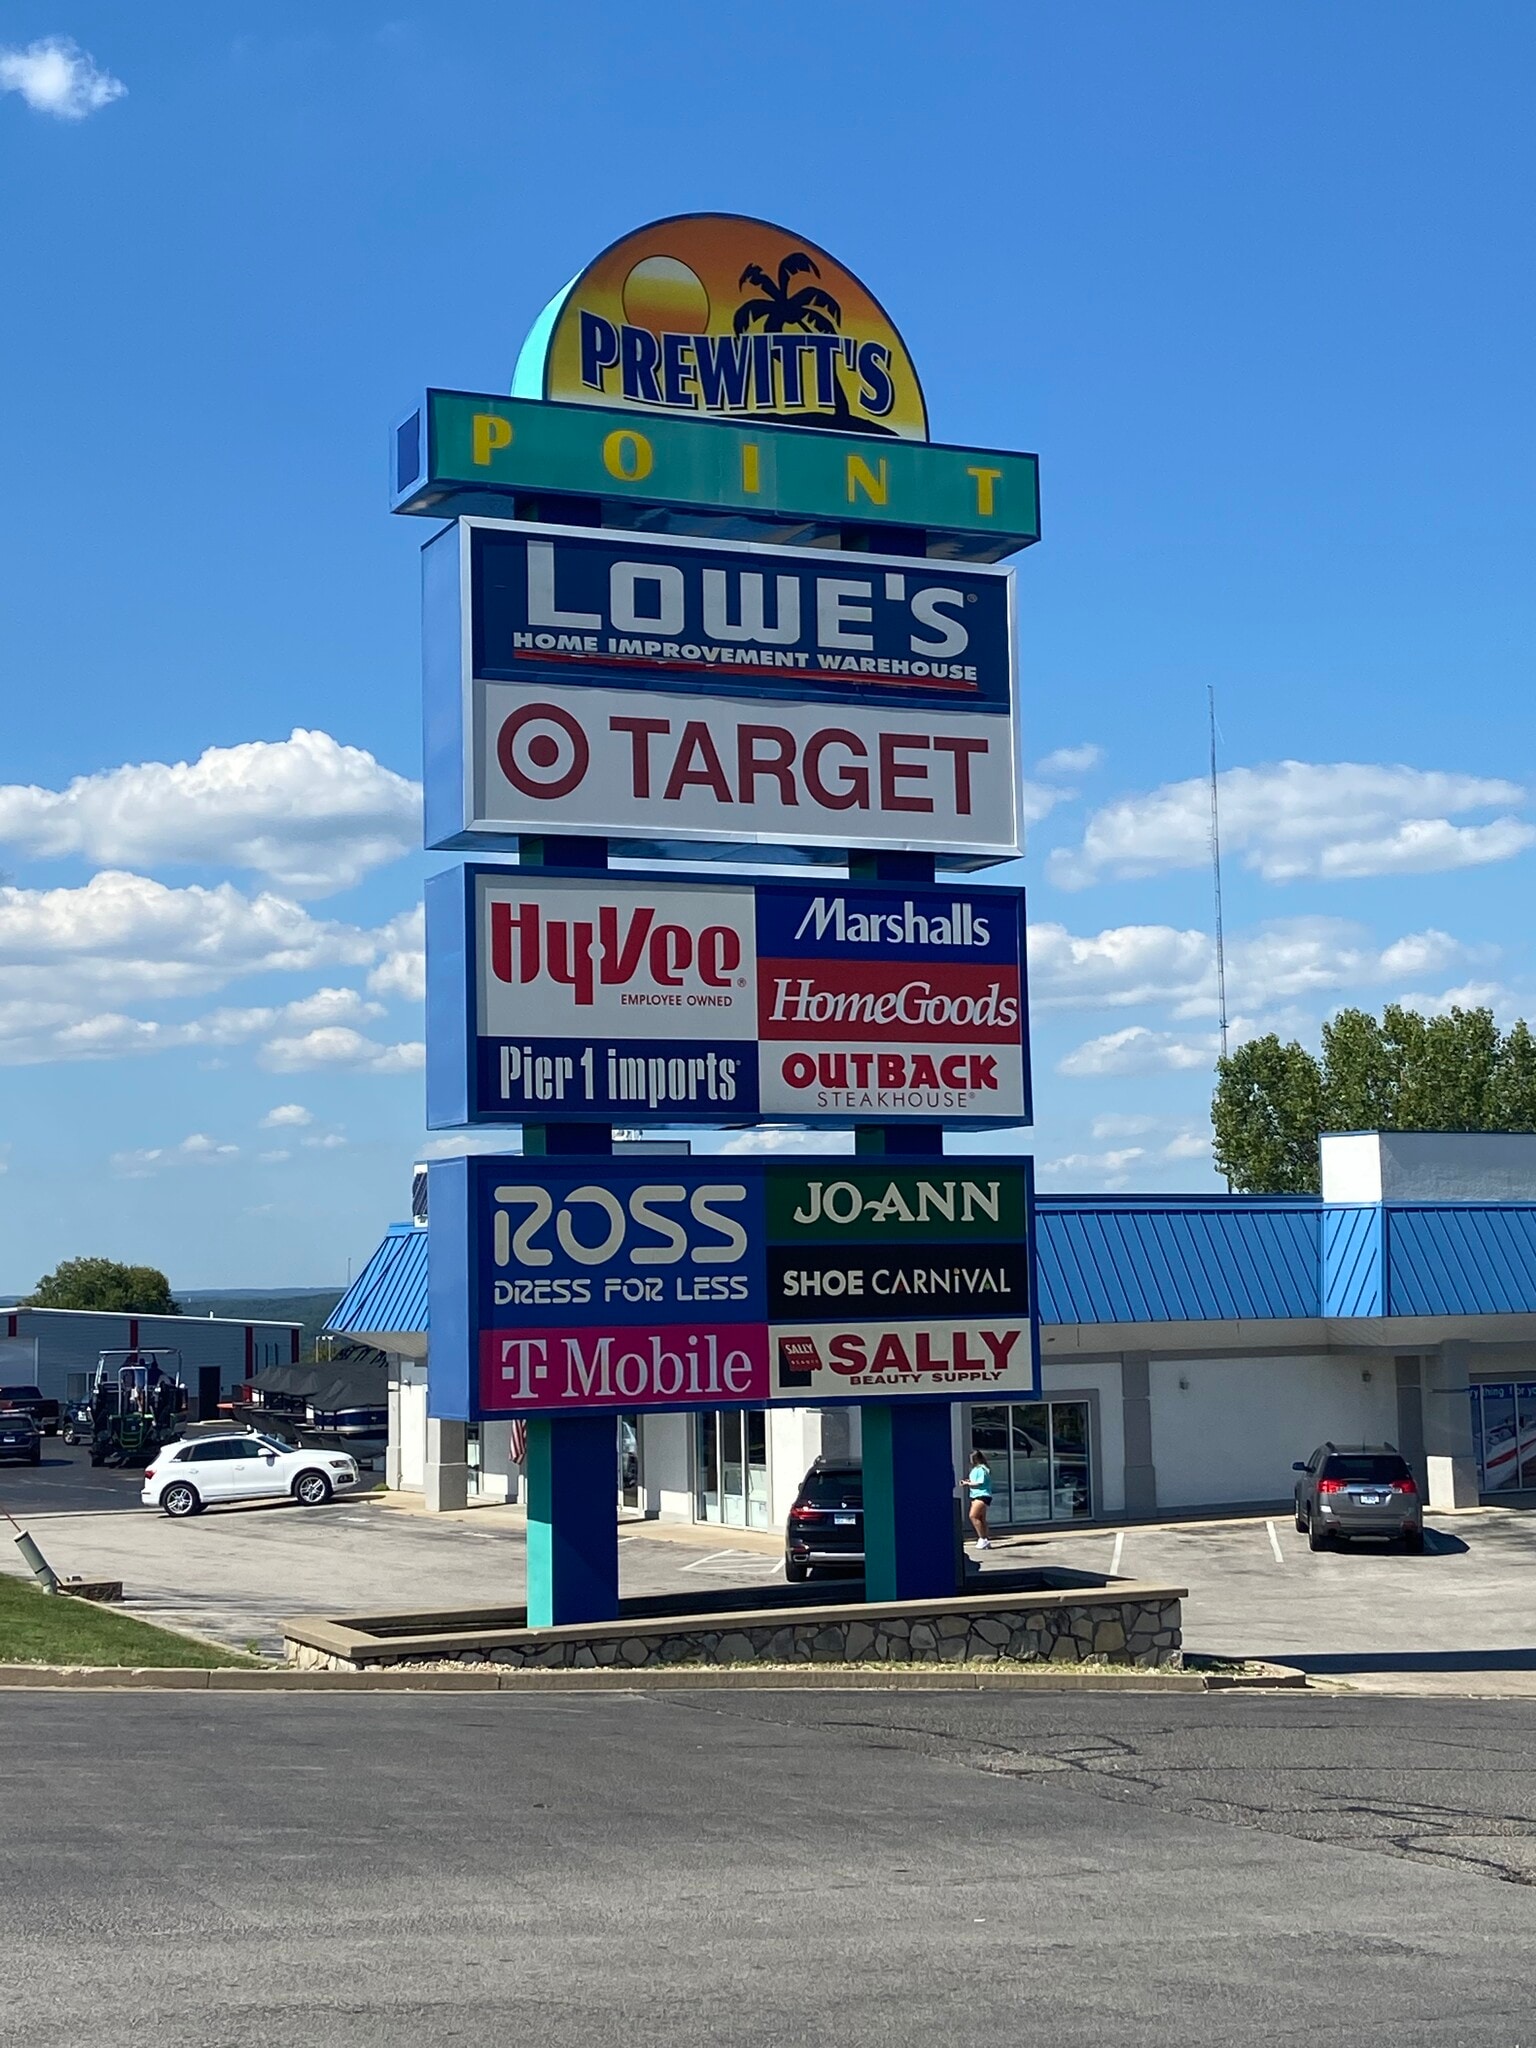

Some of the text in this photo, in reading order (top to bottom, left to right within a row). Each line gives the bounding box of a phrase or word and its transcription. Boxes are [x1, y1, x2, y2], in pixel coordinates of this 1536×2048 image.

[579, 309, 895, 416] PREWITT'S
[472, 413, 1002, 517] POINT
[527, 539, 970, 659] LOWE'S
[513, 632, 978, 682] HOME IMPROVEMENT WAREHOUSE
[609, 715, 989, 816] TARGET
[794, 896, 990, 946] Marshalls
[621, 994, 733, 1007] EMPLOYEE OWNED
[768, 978, 1018, 1028] HomeGoods
[500, 1045, 736, 1108] Pier 1 imports
[781, 1052, 999, 1090] OUTBACK
[817, 1091, 968, 1108] STEAKHOUSE
[494, 1184, 748, 1267] ROSS
[494, 1275, 749, 1305] DRESS FOR LESS
[783, 1270, 864, 1296] SHOE
[784, 1343, 815, 1355] SALLY
[828, 1330, 1022, 1375] SALLY
[850, 1371, 1003, 1386] BEAUTY SUPPLY
